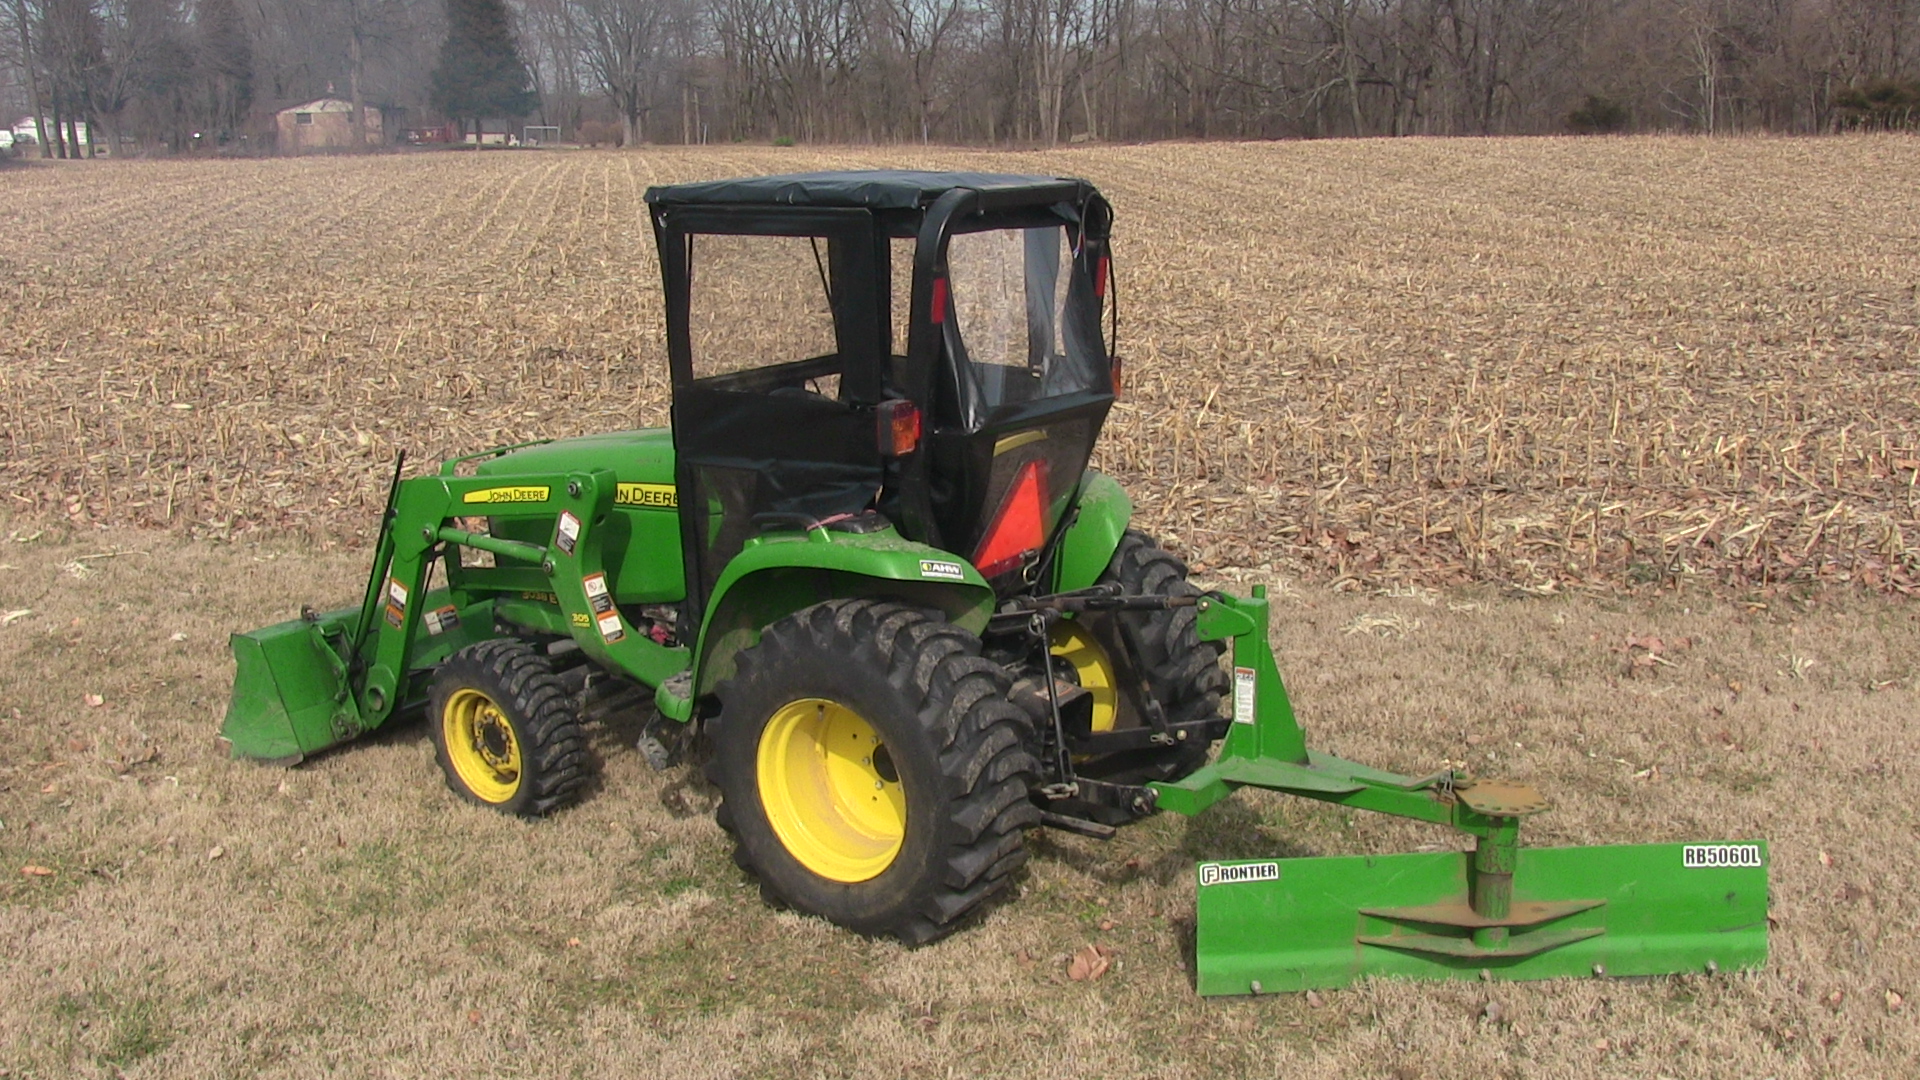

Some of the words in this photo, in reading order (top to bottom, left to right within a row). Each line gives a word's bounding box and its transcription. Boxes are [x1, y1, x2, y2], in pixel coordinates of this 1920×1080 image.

[488, 490, 512, 501] JOHN
[514, 489, 546, 500] DEERE
[571, 613, 590, 623] 305
[1685, 847, 1759, 864] RB5060L
[1202, 864, 1277, 884] FRONTIER
